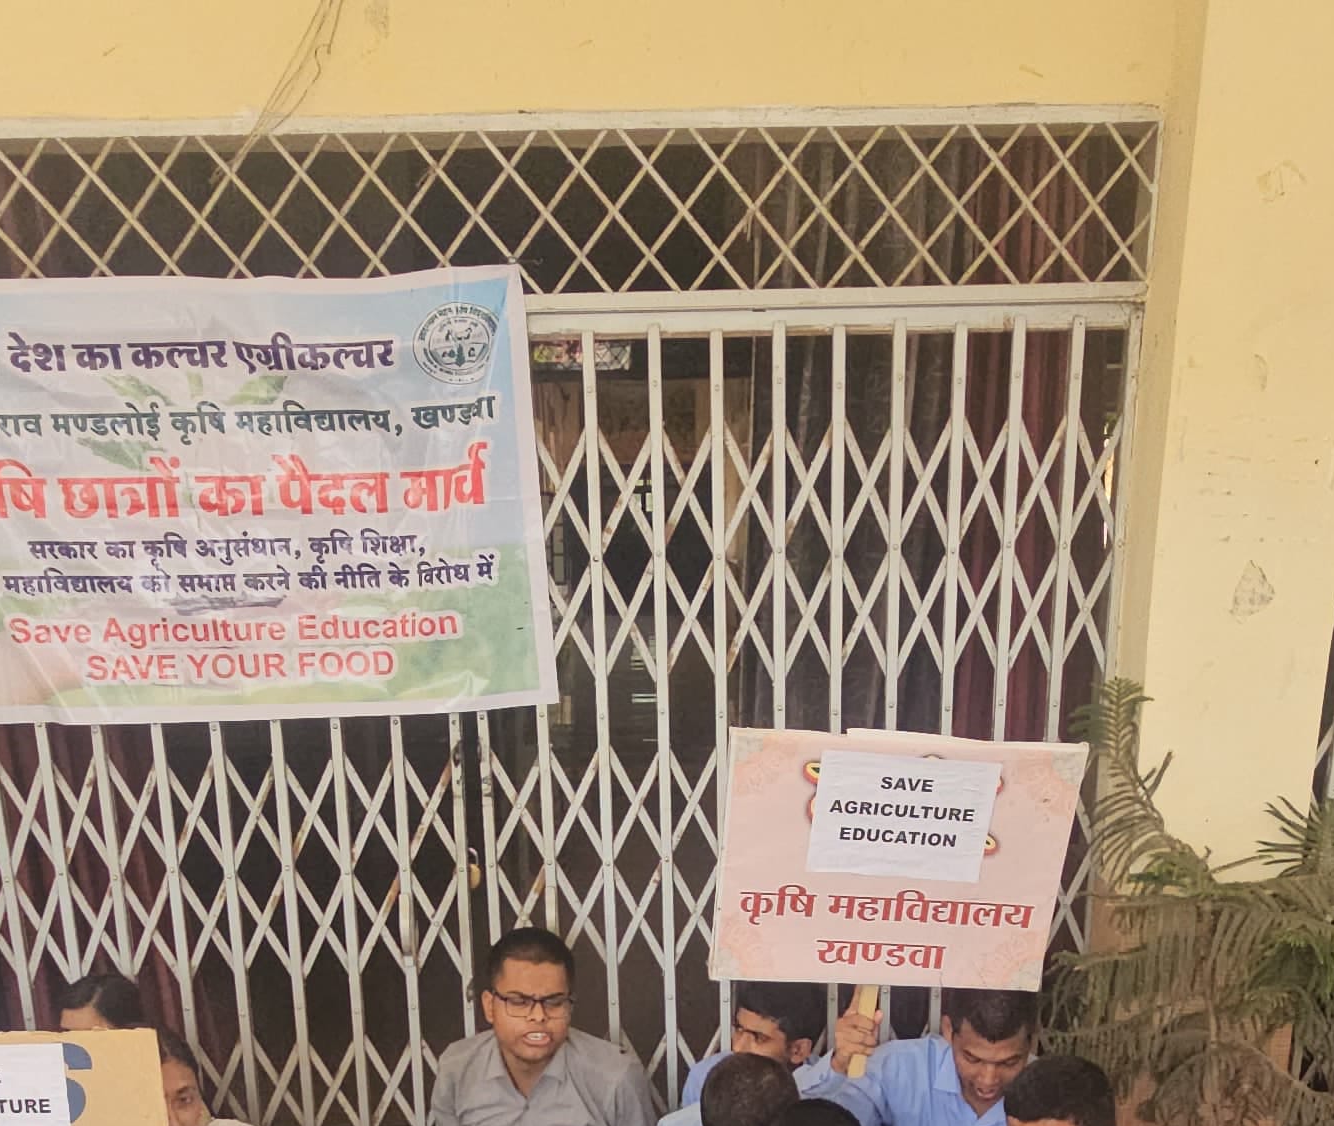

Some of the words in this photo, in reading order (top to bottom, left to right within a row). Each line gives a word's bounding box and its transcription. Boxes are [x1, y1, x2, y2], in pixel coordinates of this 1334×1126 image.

[7, 331, 67, 372] देश
[71, 343, 122, 371] का
[127, 341, 227, 369] कल्चर
[50, 402, 160, 441] मण्डलोई
[169, 401, 226, 445] कृषि
[234, 400, 403, 436] महाविद्यालय,
[57, 456, 180, 519] छात्रों
[194, 473, 266, 517] का
[271, 453, 390, 515] पैदल
[27, 540, 99, 560] सरकार
[104, 540, 136, 559] का
[141, 531, 187, 568] कृषि
[195, 531, 301, 566] अनुसंधान,
[308, 528, 353, 563] कृषि
[360, 527, 426, 558] शिक्षा,
[3, 567, 133, 596] महाविद्यालय
[139, 568, 171, 593] को
[243, 565, 291, 591] करने
[298, 564, 327, 590] की
[334, 563, 381, 589] नीति
[387, 562, 410, 588] के
[417, 558, 470, 587] विरोध
[476, 553, 495, 580] में
[9, 617, 92, 645] Save
[103, 616, 286, 649] Agriculture
[297, 611, 458, 641] Education
[87, 654, 178, 681] SAVE
[186, 652, 287, 679] YOUR
[298, 650, 394, 677] FOOD
[880, 775, 934, 793] SAVE
[829, 799, 975, 823] AGRICULTURE
[839, 827, 957, 848] EDUCATION
[739, 884, 817, 925] कृषि
[828, 890, 1035, 929] महाविद्यालय
[816, 939, 946, 970] खण्डवा
